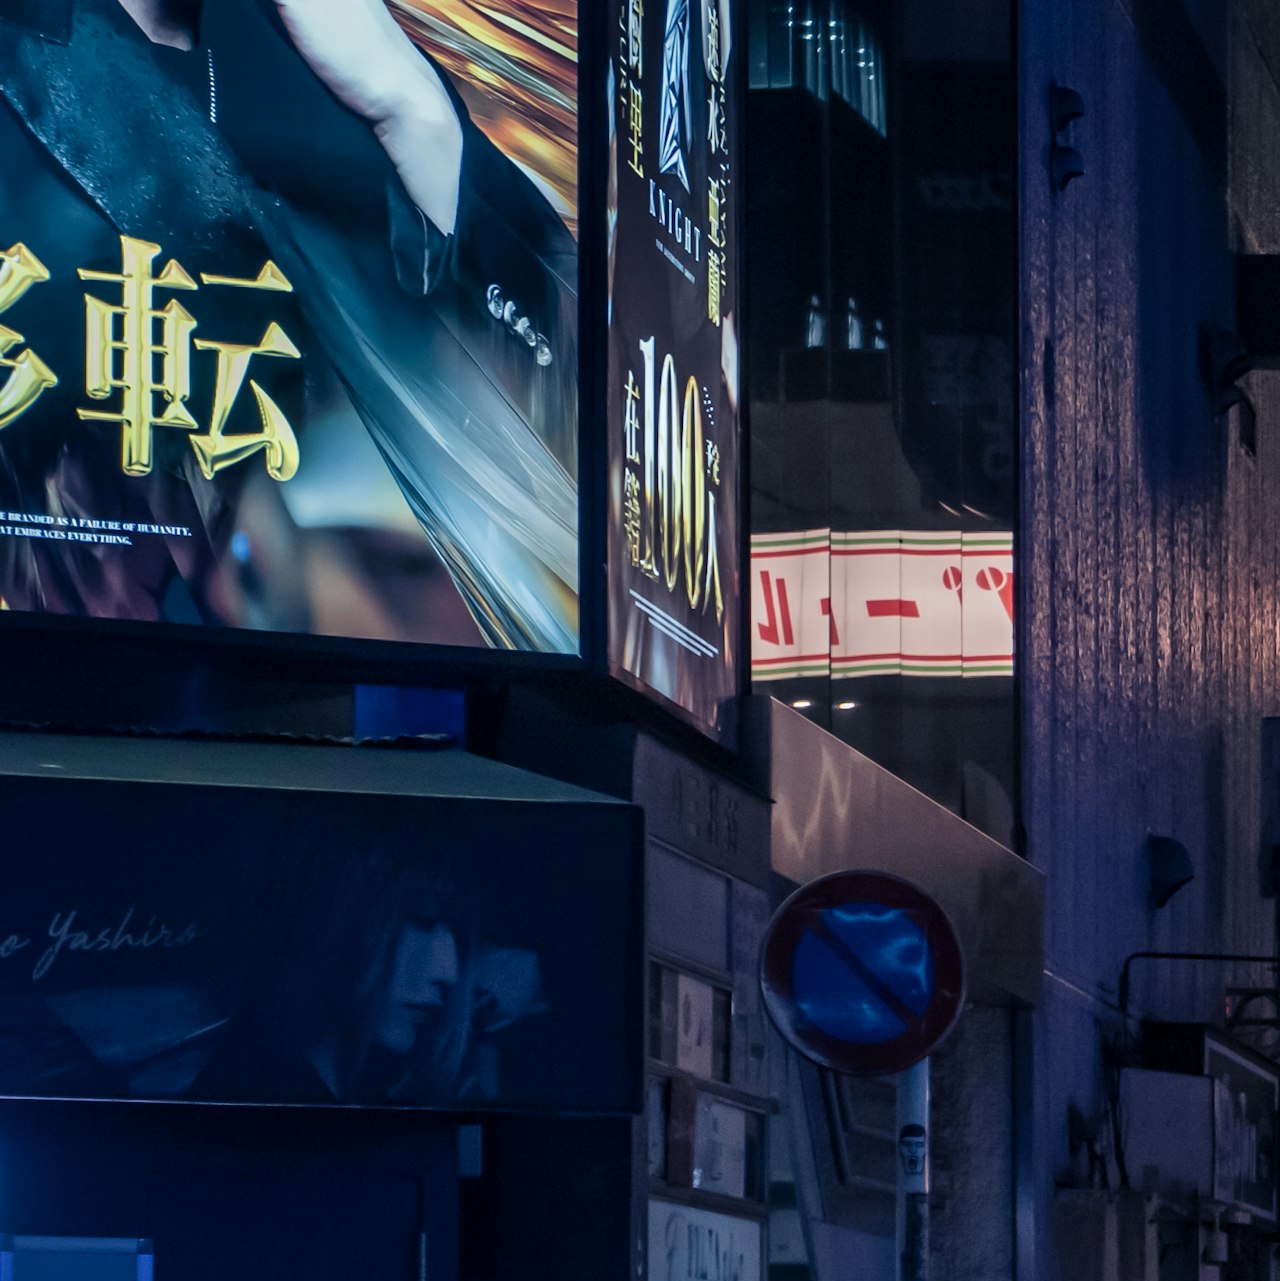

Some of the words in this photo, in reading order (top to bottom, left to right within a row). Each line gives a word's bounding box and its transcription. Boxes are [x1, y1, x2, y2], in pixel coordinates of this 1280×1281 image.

[649, 178, 701, 262] KNIGHT
[8, 512, 54, 525] BRANDED
[56, 516, 70, 526] AS
[71, 518, 78, 527] A
[79, 519, 121, 531] FAILURE
[123, 522, 136, 531] OF
[14, 527, 66, 540] EMBRACES
